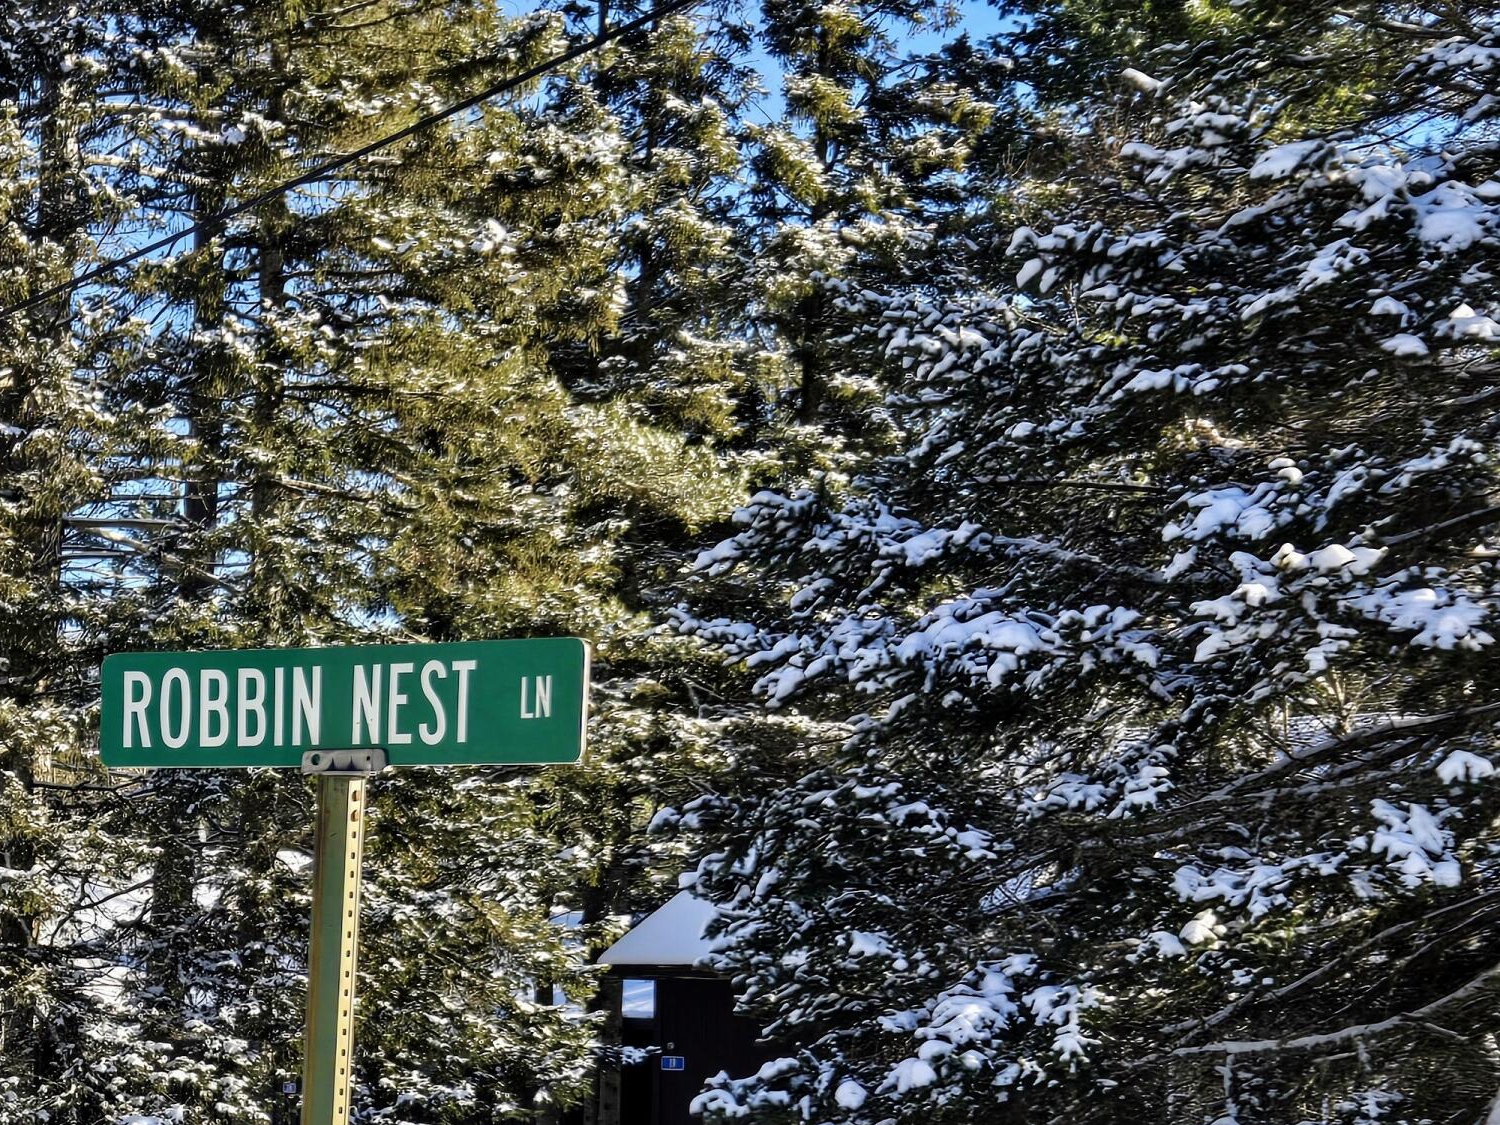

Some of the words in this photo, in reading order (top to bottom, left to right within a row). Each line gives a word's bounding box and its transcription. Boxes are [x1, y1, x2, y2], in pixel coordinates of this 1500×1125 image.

[122, 665, 322, 749] ROBBIN
[351, 659, 478, 746] NEST
[520, 675, 553, 719] LN
